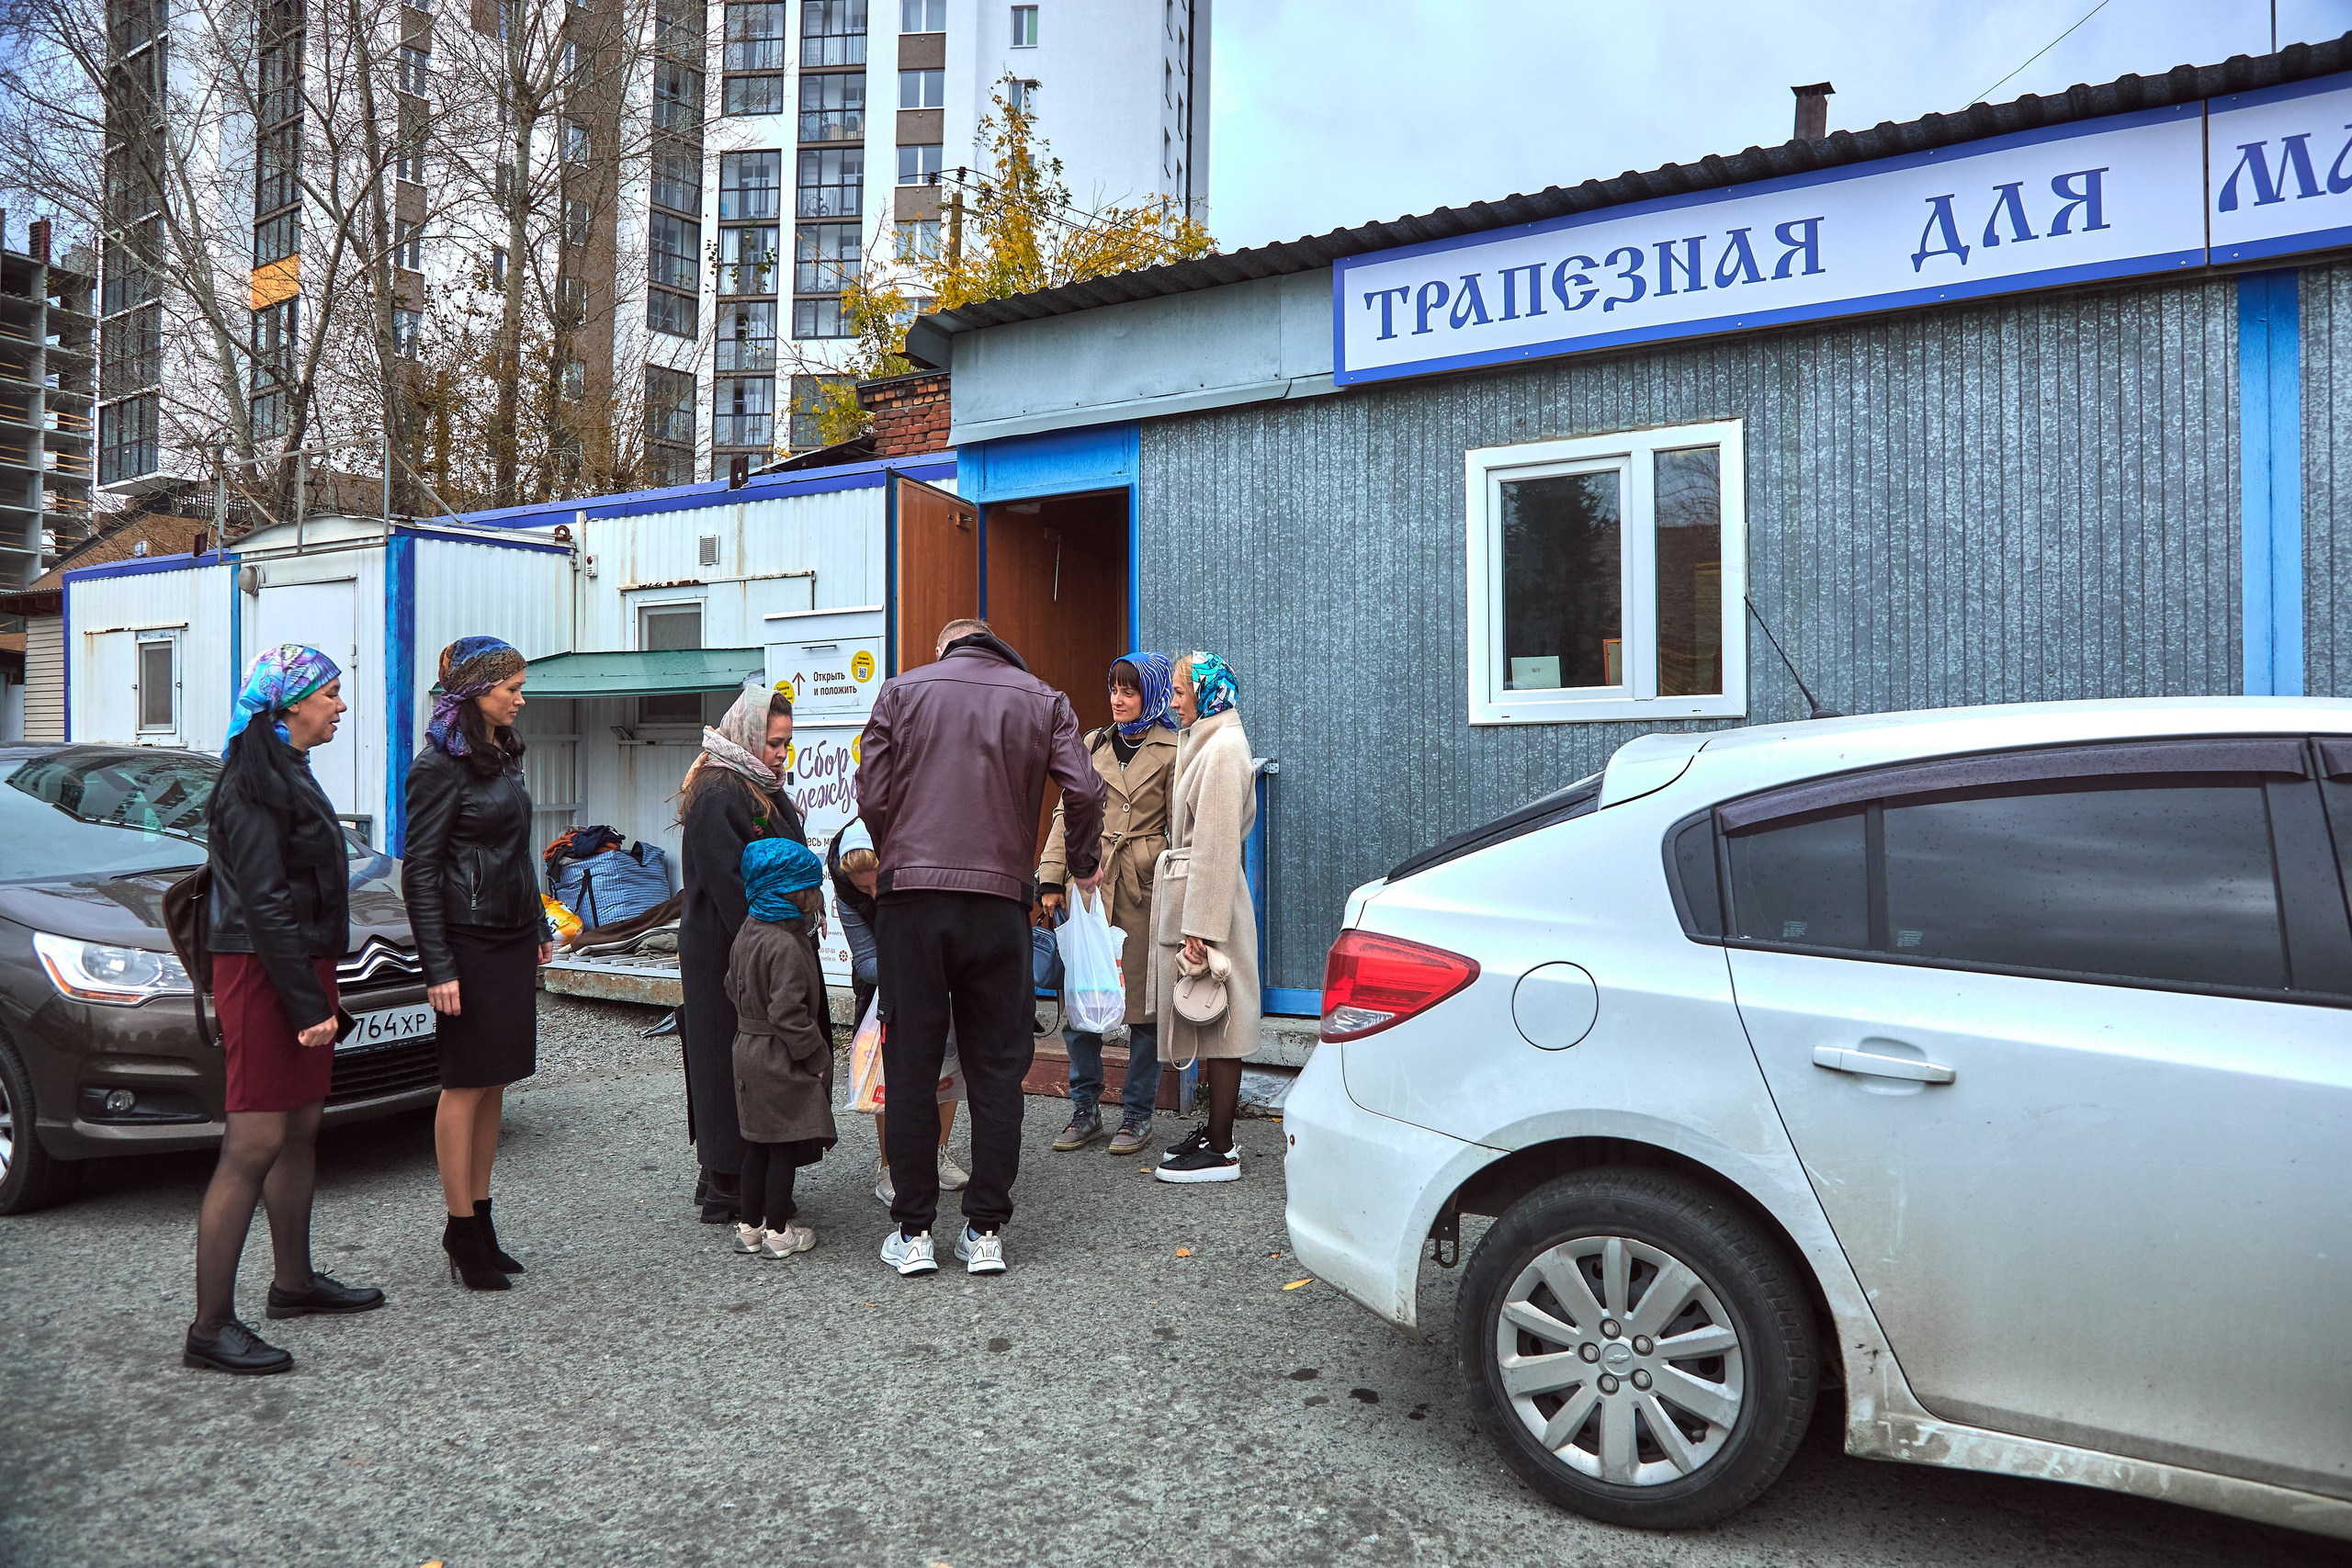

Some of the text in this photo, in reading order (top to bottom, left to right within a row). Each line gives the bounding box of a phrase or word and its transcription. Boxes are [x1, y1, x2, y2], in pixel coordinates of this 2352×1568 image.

[1363, 217, 1826, 341] ТРАПЕЗНАЯ
[1910, 167, 2110, 274] ДЛЯ
[813, 671, 846, 683] Открыть
[813, 685, 858, 696] и положить
[797, 739, 851, 784] Сбор
[355, 1012, 427, 1043] 764ХР
